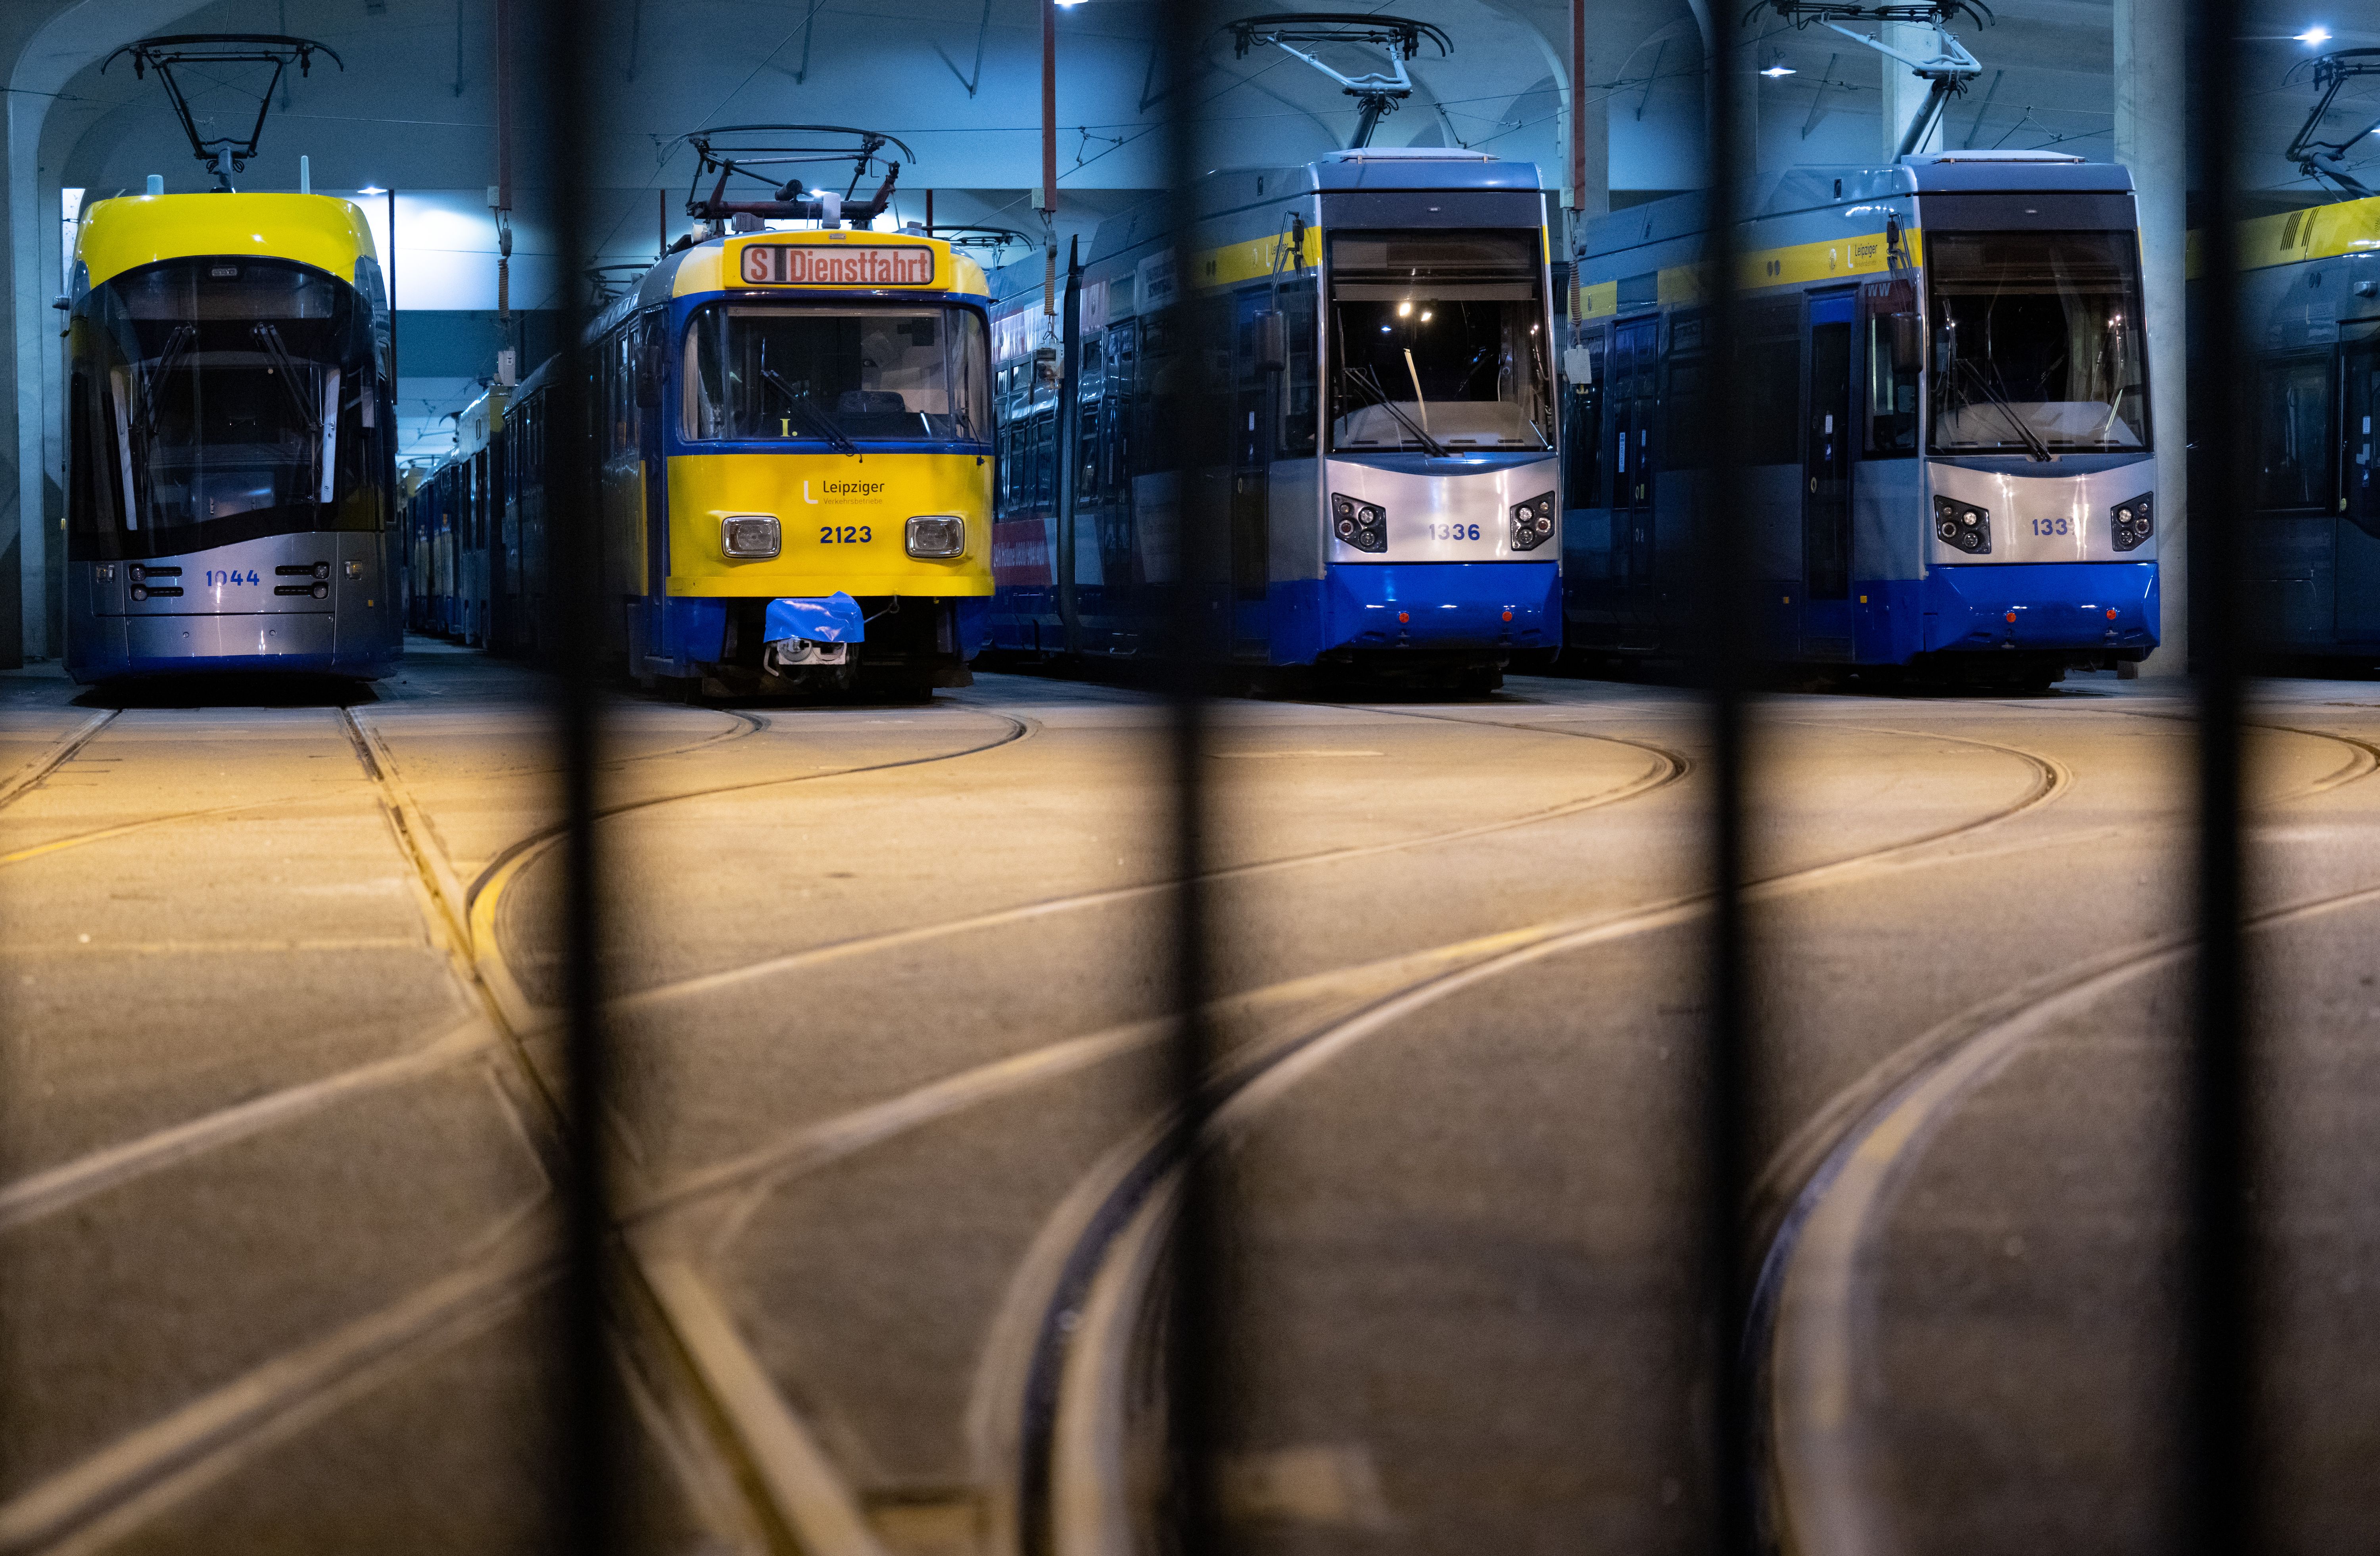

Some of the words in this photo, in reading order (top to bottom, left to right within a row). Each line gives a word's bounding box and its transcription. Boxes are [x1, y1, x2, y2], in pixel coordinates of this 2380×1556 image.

[1854, 243, 1877, 259] Leipziger
[750, 248, 768, 280] S
[790, 250, 927, 282] Dienstfahrt
[823, 480, 885, 496] Leipziger
[820, 526, 872, 543] 2123
[1429, 524, 1480, 541] 1336
[206, 570, 260, 586] 1044
